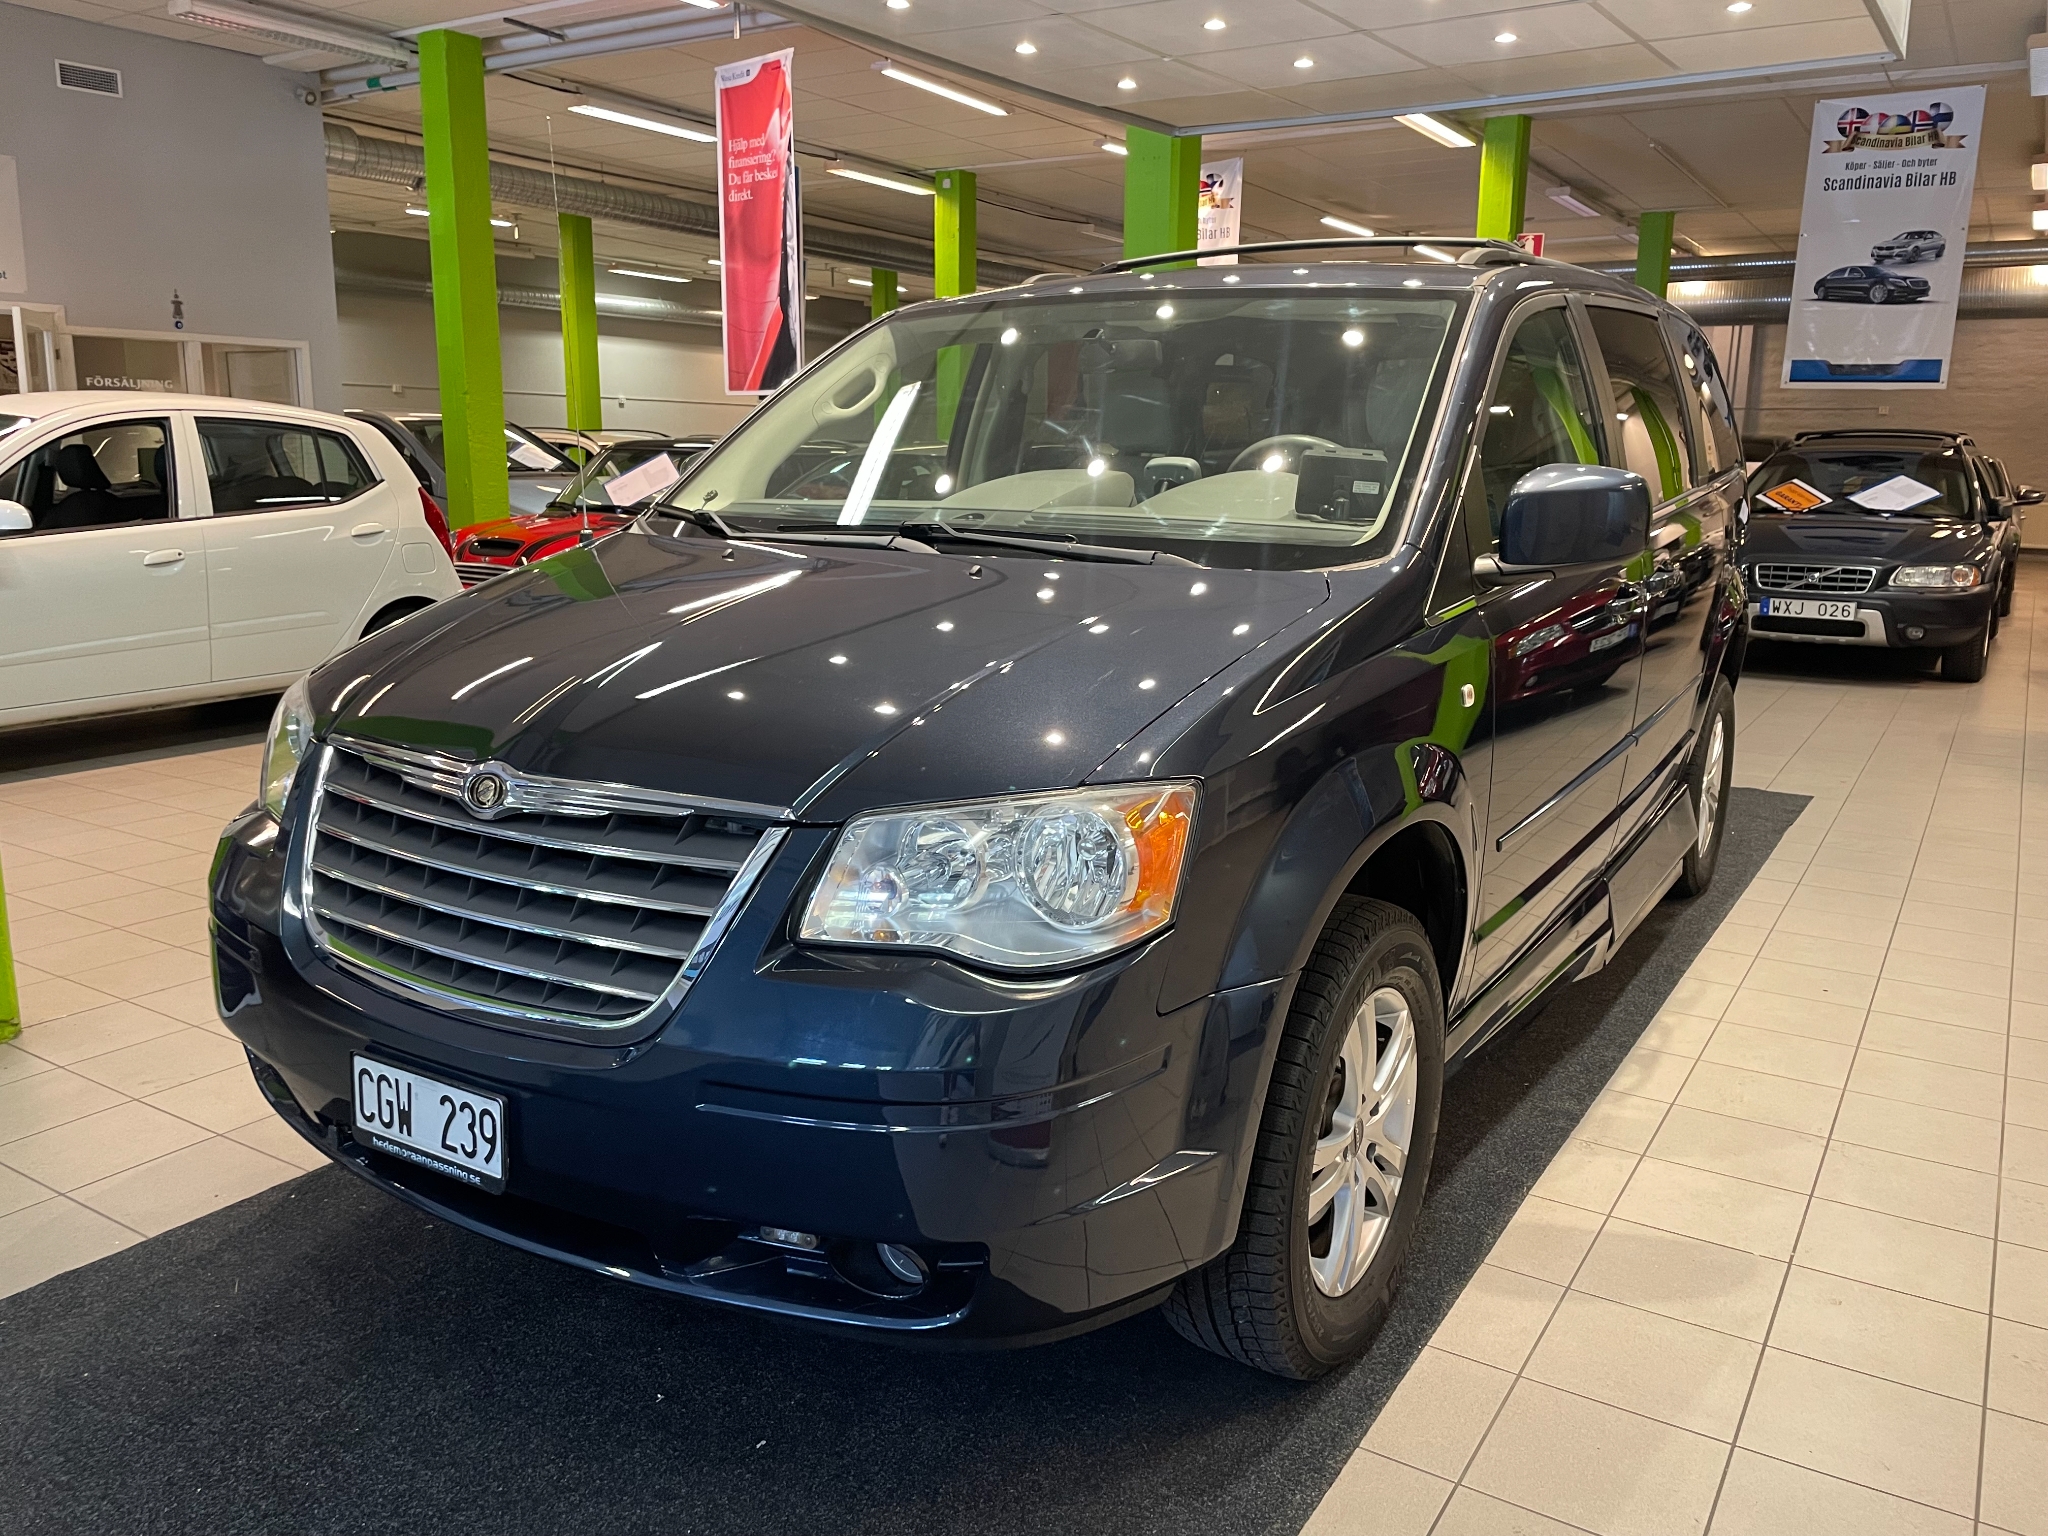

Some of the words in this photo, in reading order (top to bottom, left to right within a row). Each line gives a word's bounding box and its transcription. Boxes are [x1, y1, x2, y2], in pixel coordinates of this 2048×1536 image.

[728, 137, 748, 154] Hjälp
[749, 134, 766, 148] med
[1851, 134, 1903, 148] Scandinavia
[1905, 134, 1926, 147] Bilar
[728, 149, 777, 169] finansiering?
[1845, 161, 1867, 171] Köper
[1873, 160, 1895, 170] Säljer
[1901, 159, 1916, 168] Och
[1917, 158, 1938, 168] byter
[728, 173, 741, 185] Du
[742, 170, 753, 183] får
[1823, 173, 1902, 191] Scandinavia
[1905, 172, 1937, 187] Bilar
[1939, 171, 1957, 186] HB
[1220, 227, 1230, 238] HB
[86, 375, 173, 389] FÖRSÄLJNING
[1772, 601, 1805, 615] WXJ
[1817, 602, 1851, 618] 026
[358, 1067, 412, 1137] CGW
[439, 1094, 497, 1165] 239
